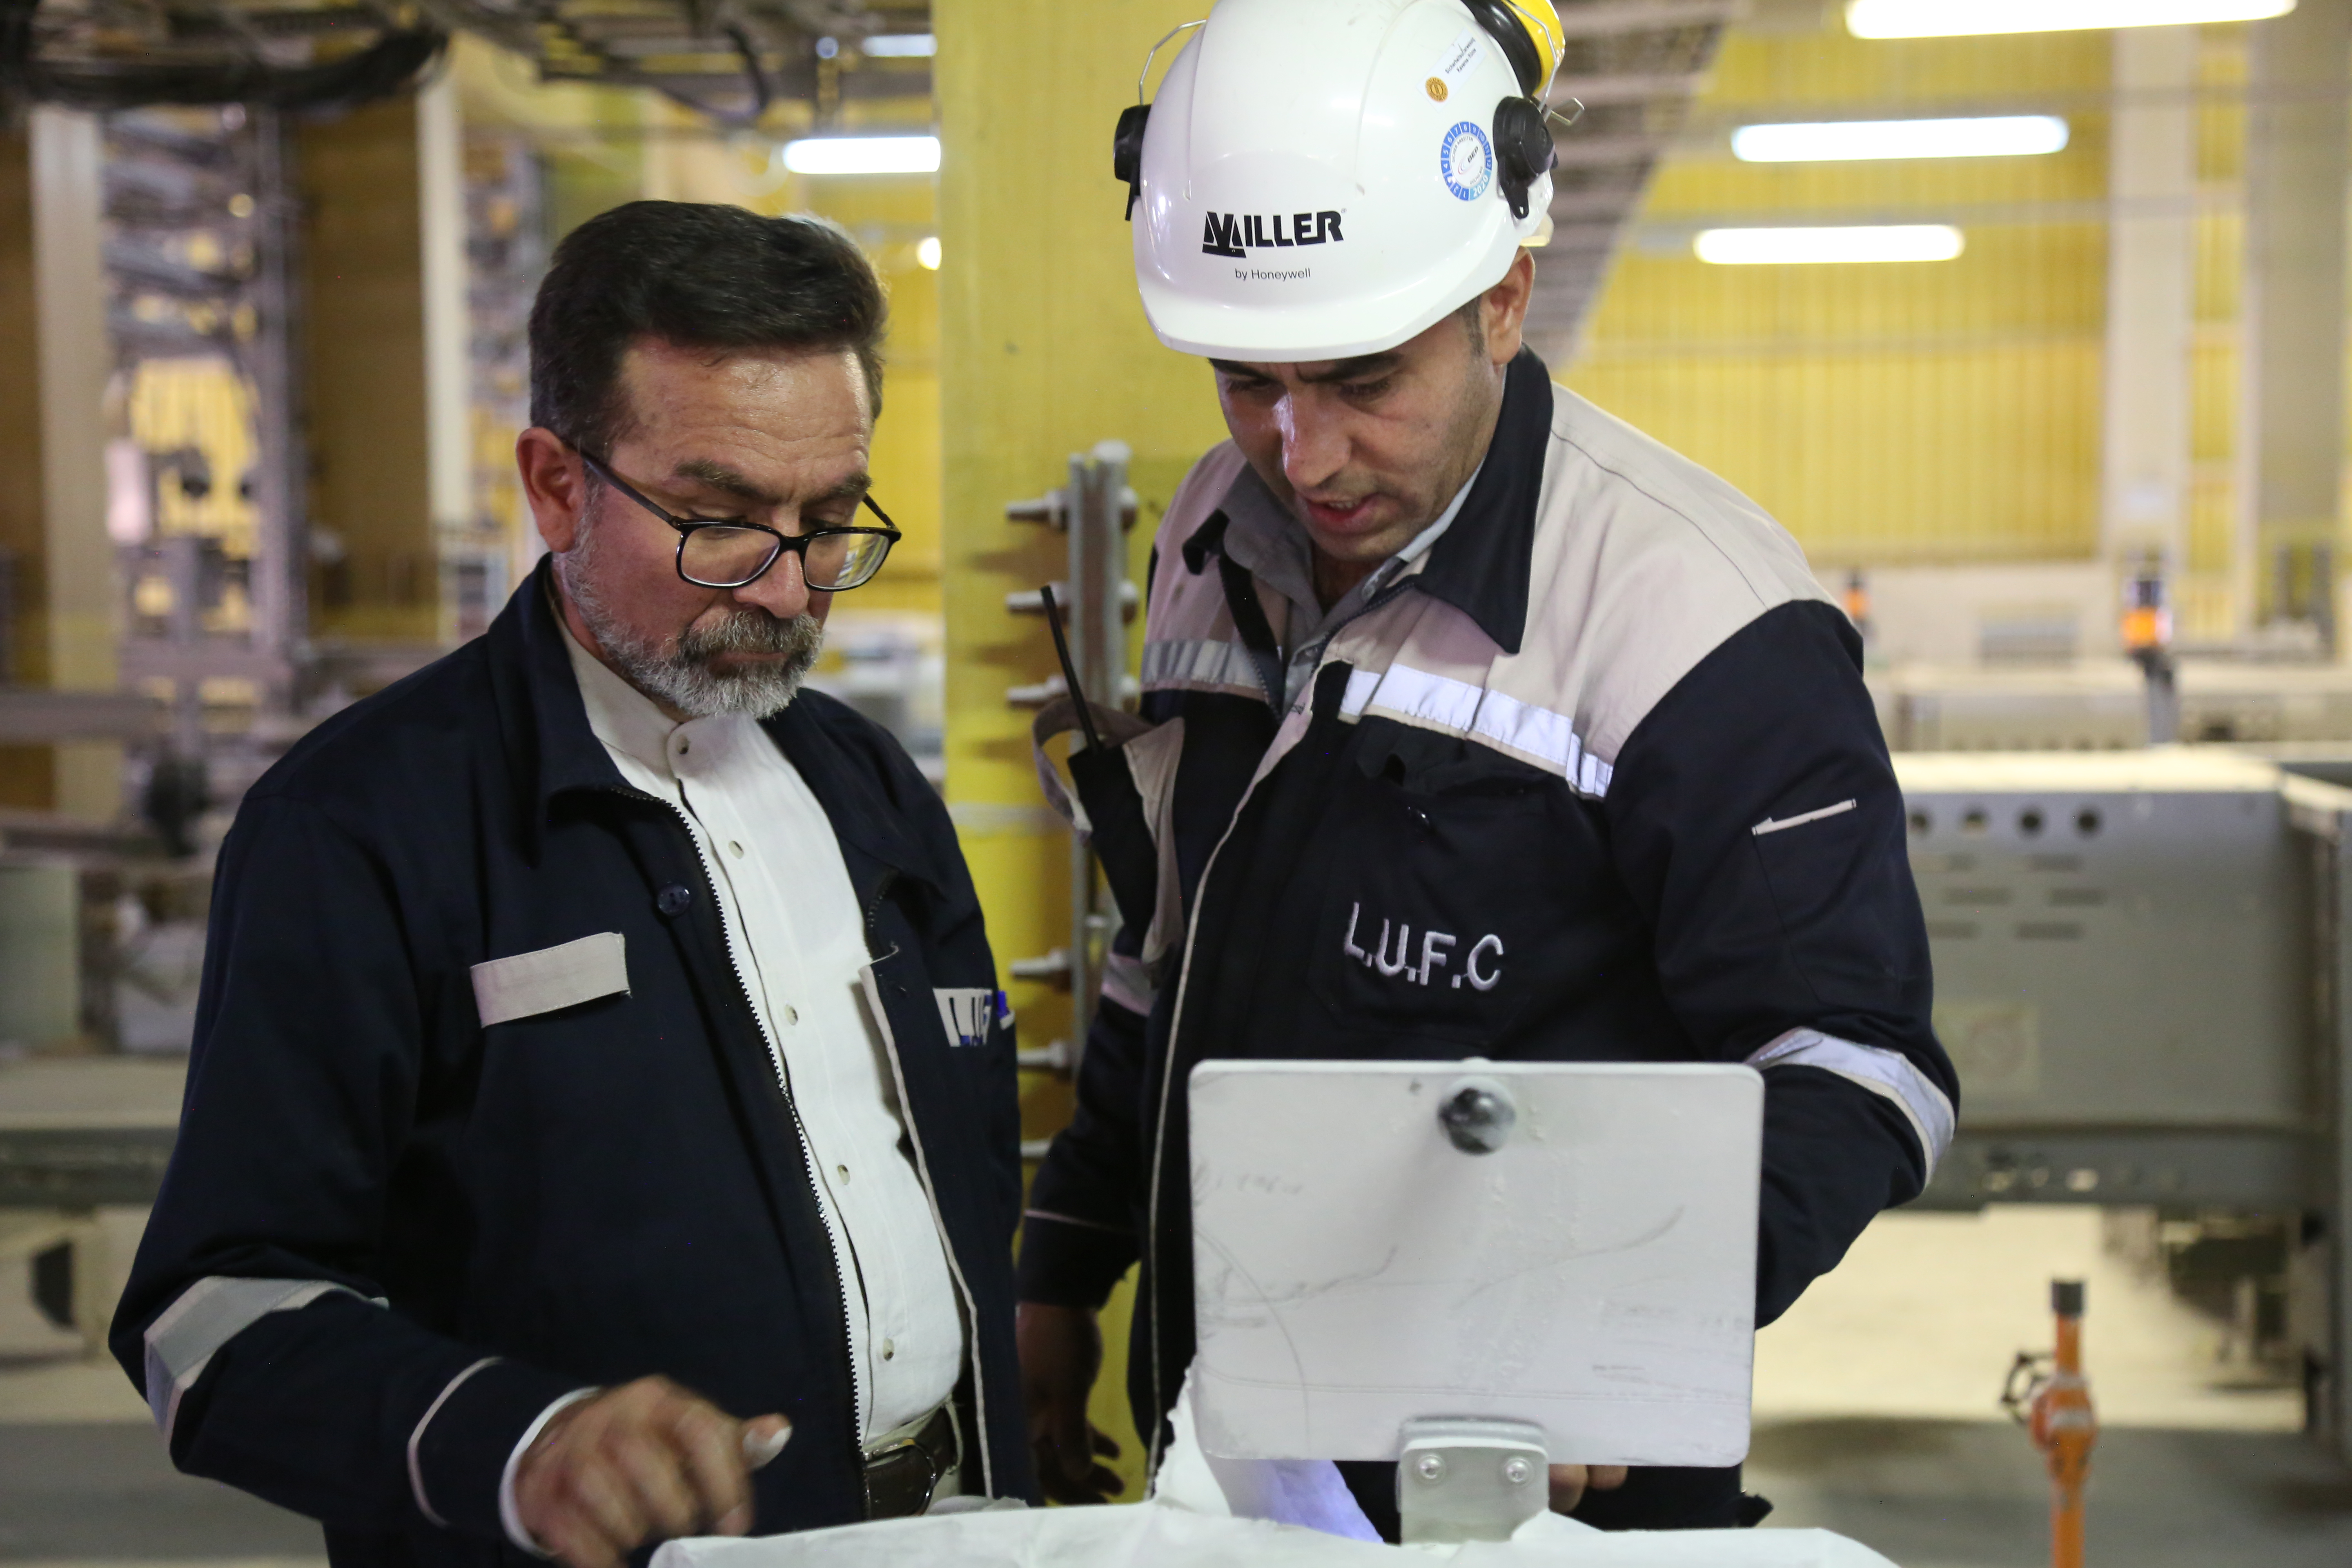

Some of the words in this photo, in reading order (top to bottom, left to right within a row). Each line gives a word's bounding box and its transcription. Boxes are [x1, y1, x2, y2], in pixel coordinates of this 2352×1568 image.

[1454, 127, 1458, 135] 7
[1463, 123, 1468, 131] 8
[1479, 132, 1485, 142] 10
[1467, 146, 1478, 163] BEP
[1473, 174, 1488, 197] 2020
[1202, 211, 1344, 258] MILLER
[1235, 268, 1247, 282] by
[1251, 267, 1311, 282] Honeywell
[1343, 902, 1503, 991] L.U.F.C
